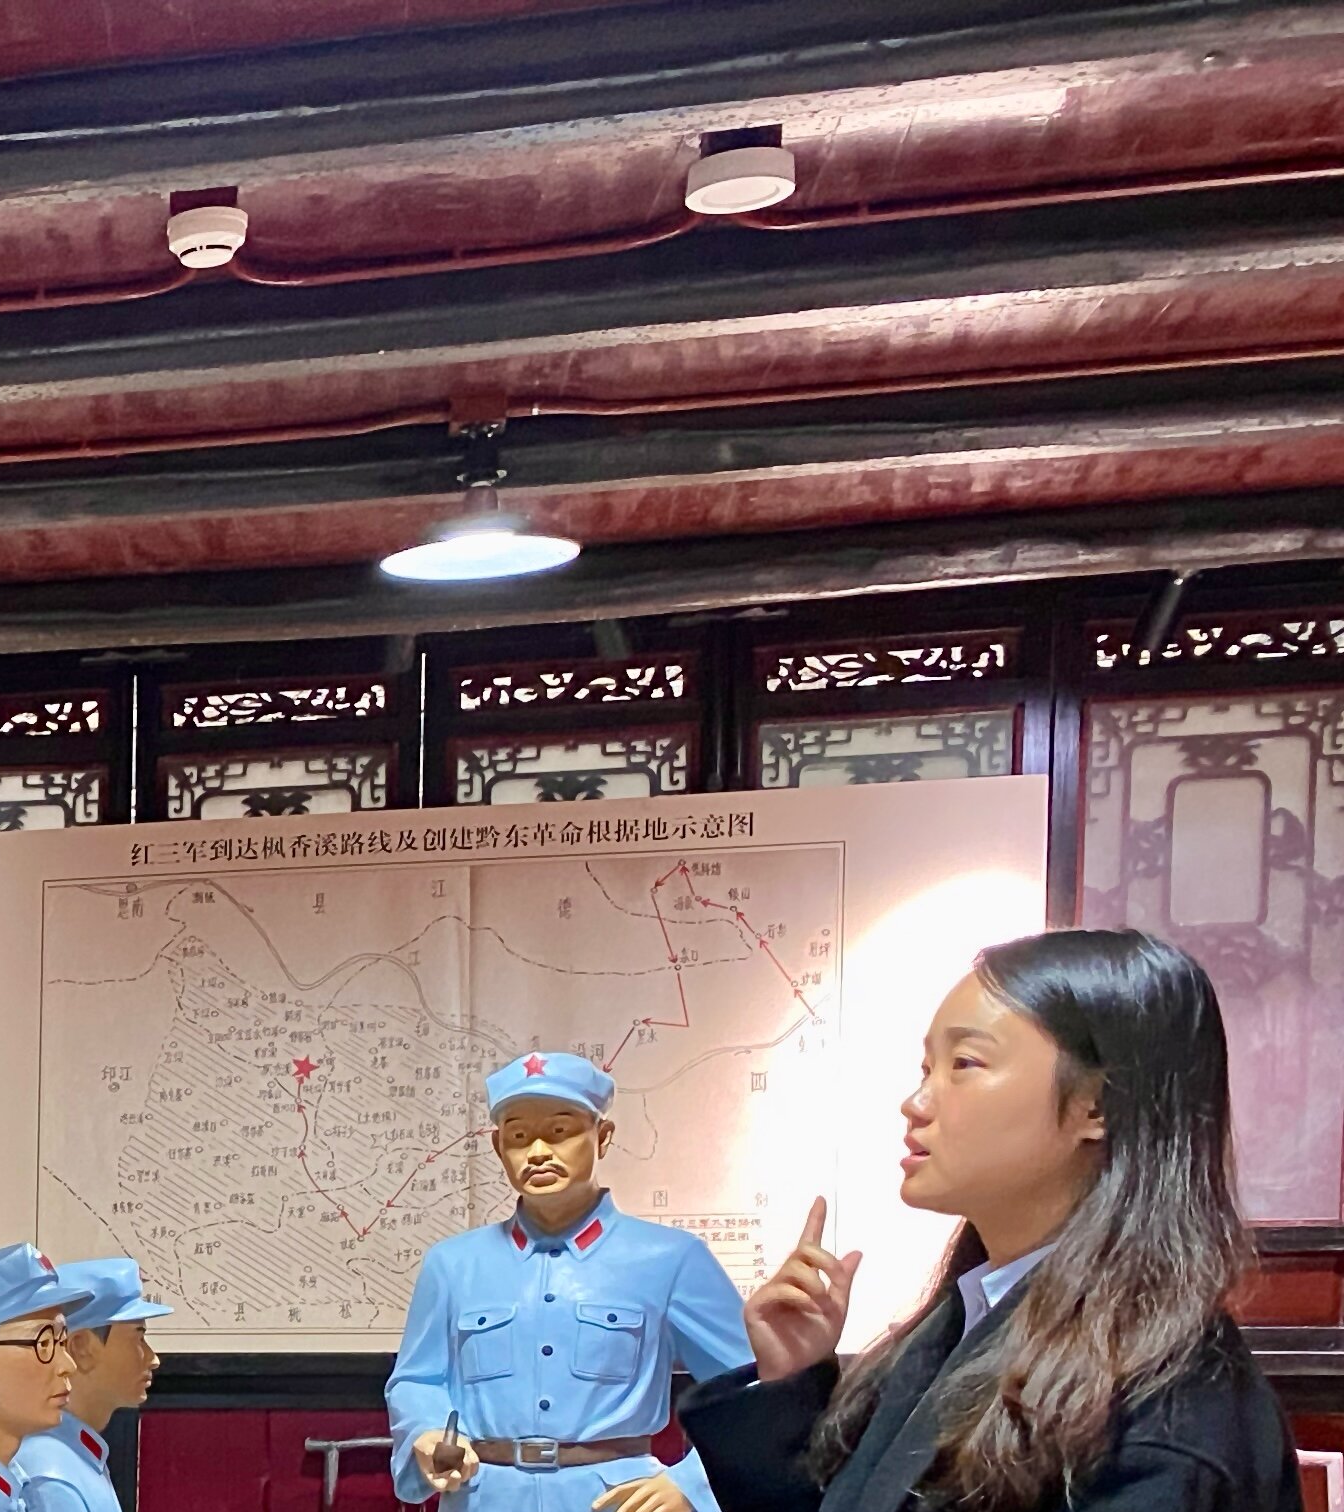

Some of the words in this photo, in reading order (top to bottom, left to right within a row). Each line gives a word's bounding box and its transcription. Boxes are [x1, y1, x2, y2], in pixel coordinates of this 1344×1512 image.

[131, 811, 754, 867] 红三军到达枫香溪路线及创建黔东革命根据地示意图
[101, 1065, 133, 1082] 印江
